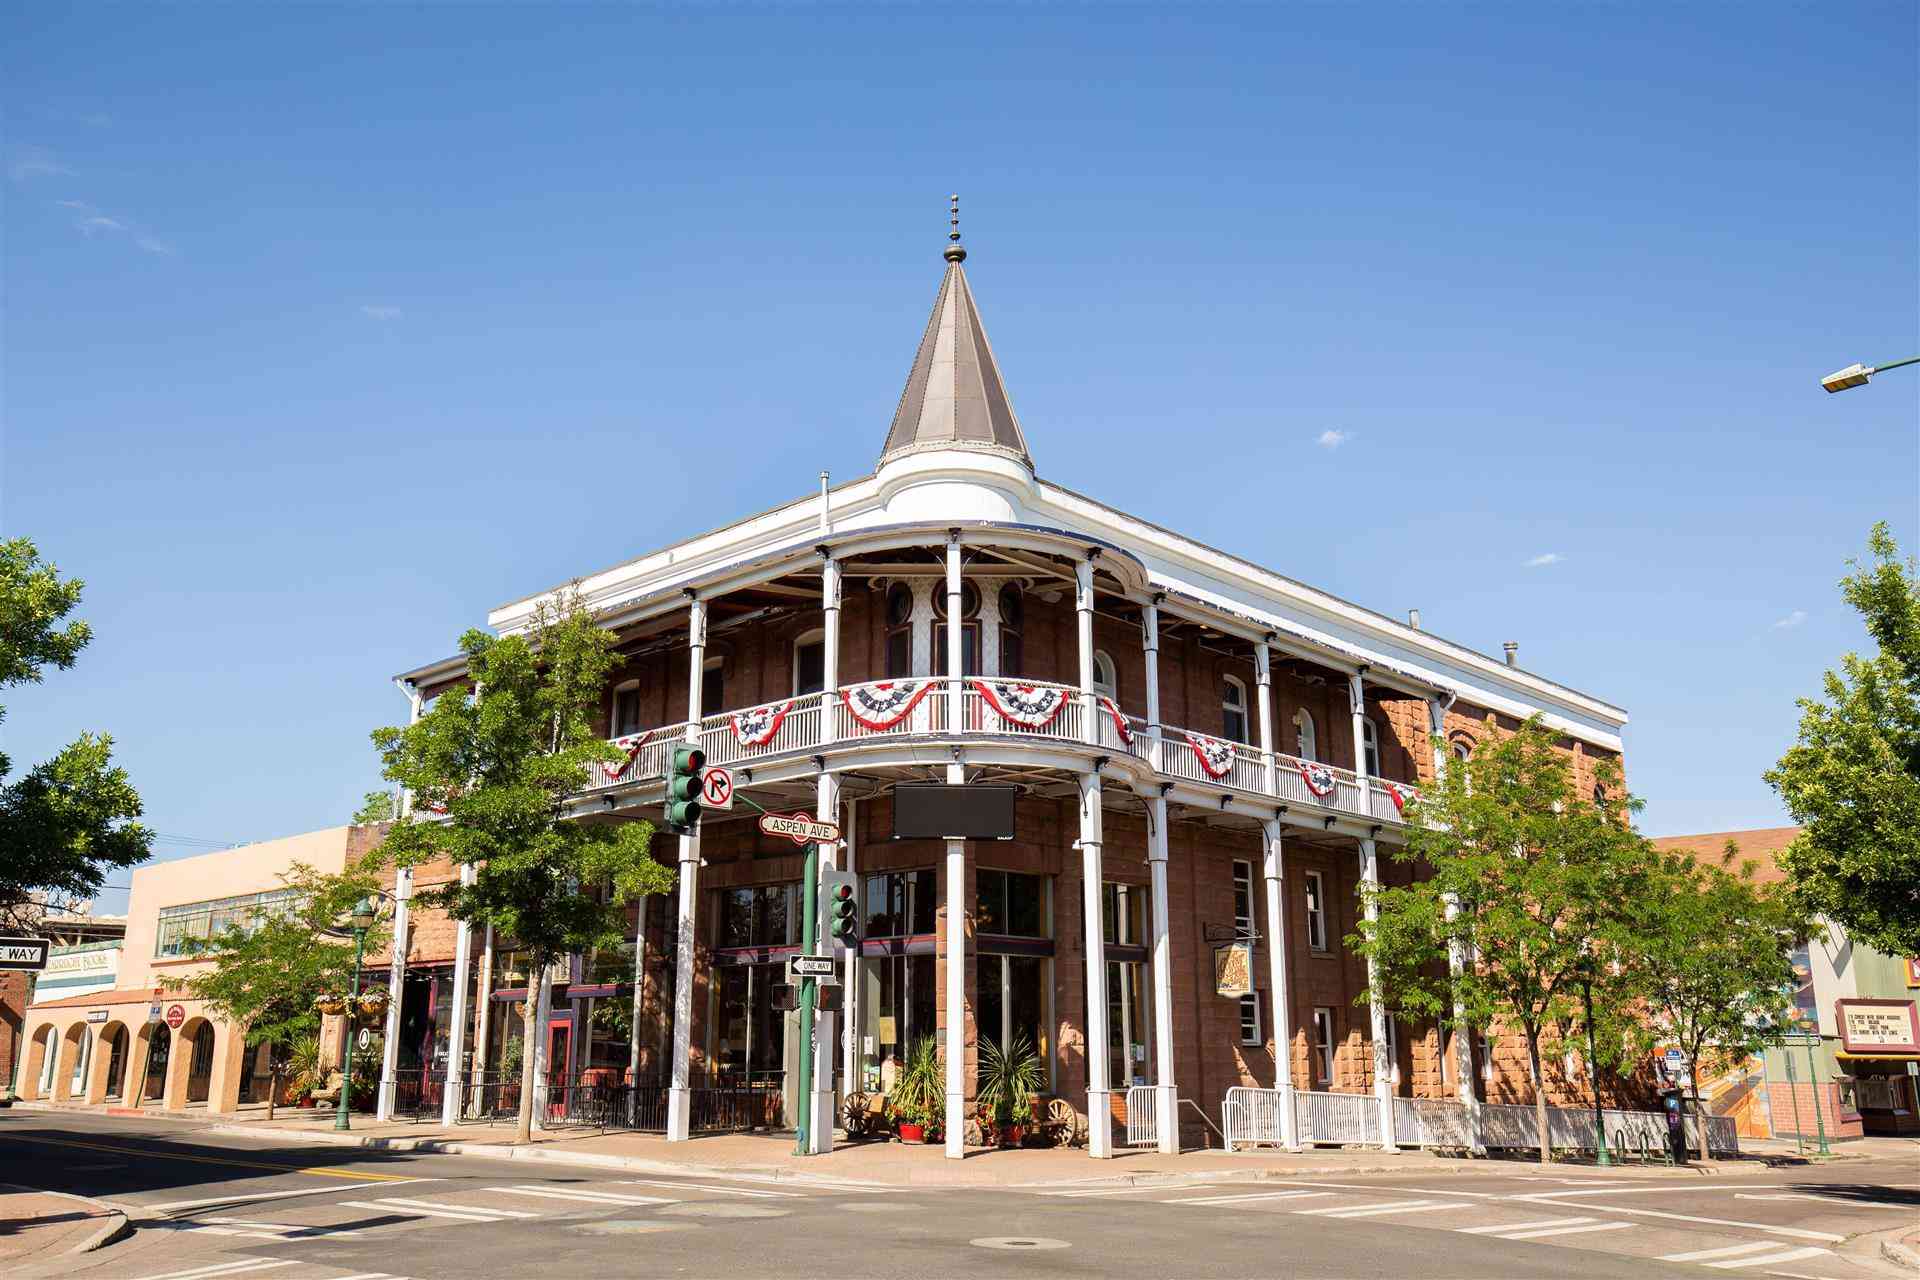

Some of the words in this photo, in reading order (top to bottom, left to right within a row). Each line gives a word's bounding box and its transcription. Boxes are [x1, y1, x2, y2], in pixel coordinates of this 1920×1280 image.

[772, 819, 806, 834] ASPEN
[810, 825, 830, 838] AVE
[8, 948, 37, 960] WAY
[803, 961, 816, 970] ONE
[817, 961, 830, 970] WAY
